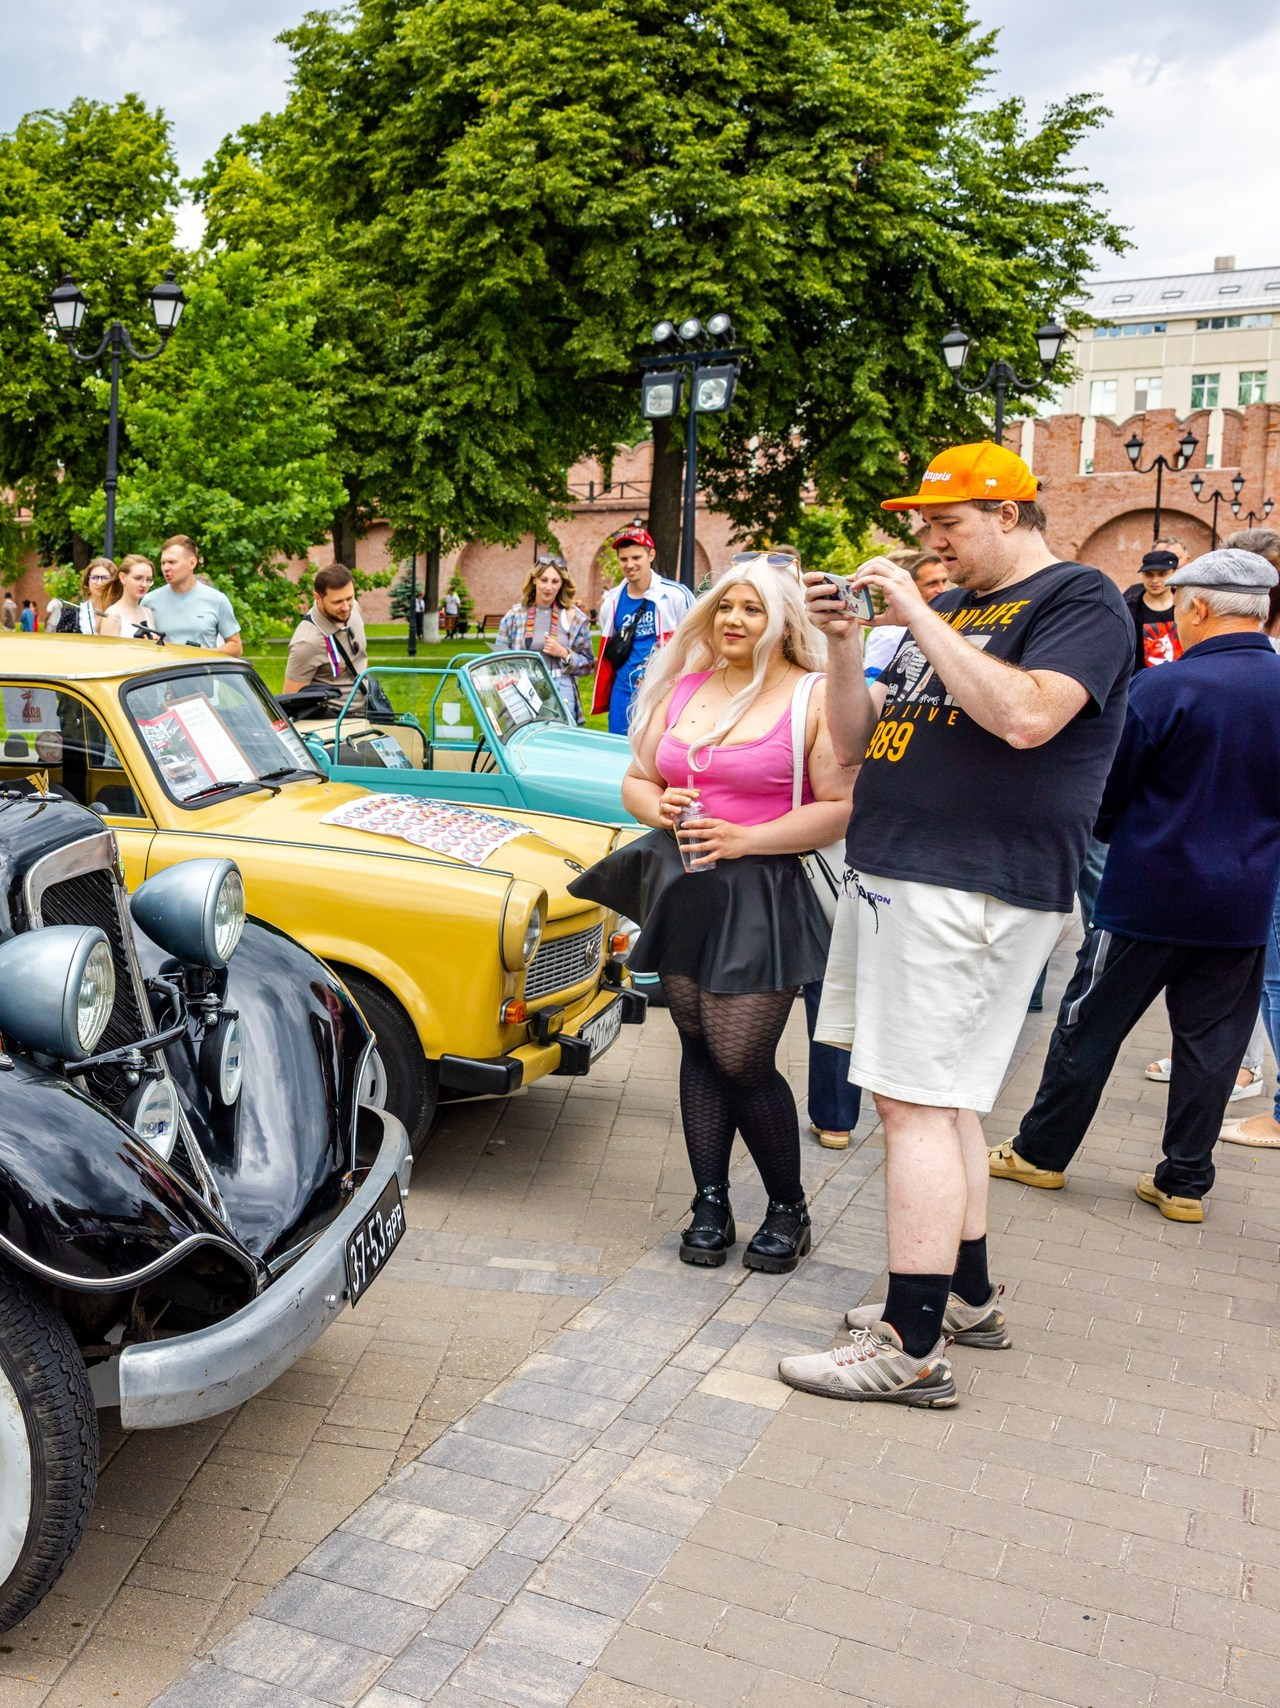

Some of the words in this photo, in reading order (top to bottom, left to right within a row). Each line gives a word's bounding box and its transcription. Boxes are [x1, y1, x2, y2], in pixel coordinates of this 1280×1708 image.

[922, 470, 952, 483] ngels
[972, 600, 1032, 627] LIFE
[635, 627, 655, 637] SSIA
[350, 1211, 386, 1293] 37-53
